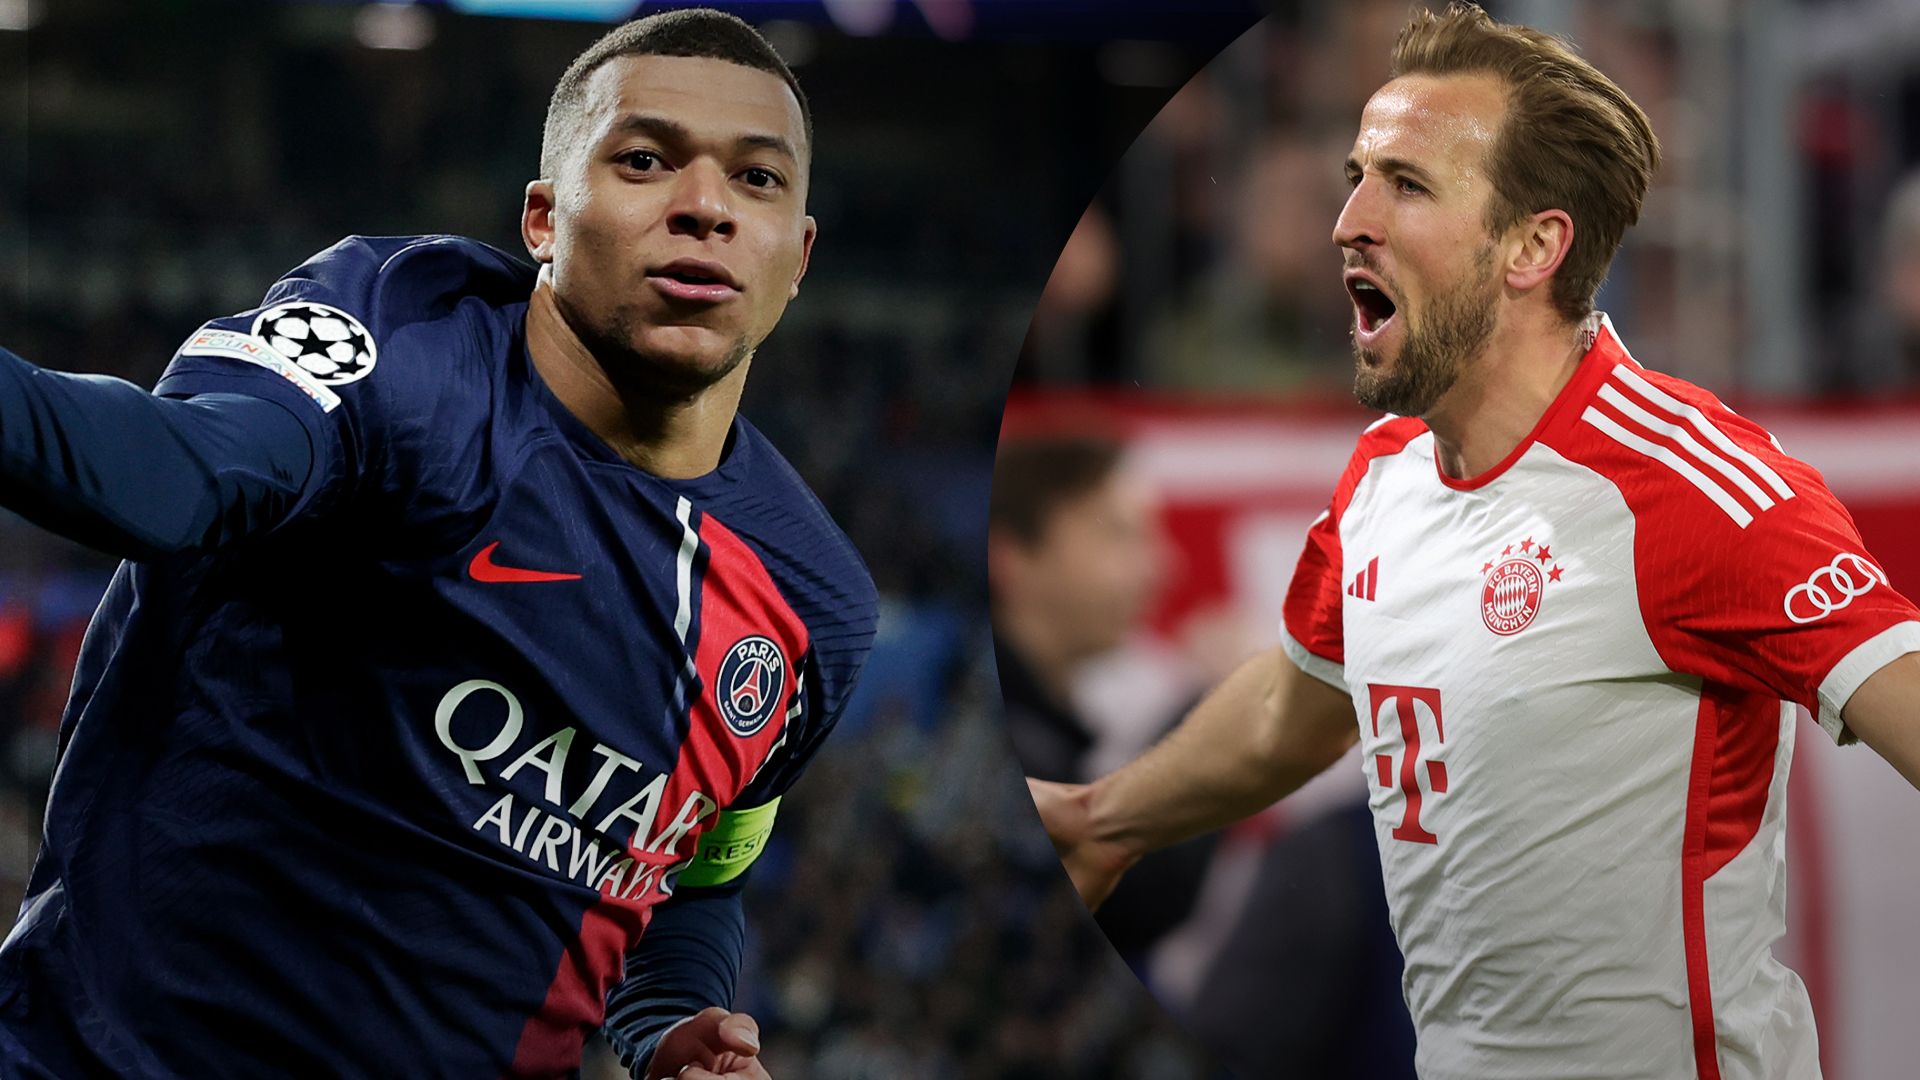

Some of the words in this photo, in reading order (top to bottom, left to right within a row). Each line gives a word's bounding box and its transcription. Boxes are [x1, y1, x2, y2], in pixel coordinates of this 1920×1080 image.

[1488, 573, 1502, 590] FC
[1504, 563, 1538, 593] BAYERN
[736, 642, 781, 672] PARIS
[434, 679, 716, 856] QATAR
[1366, 683, 1448, 846] T
